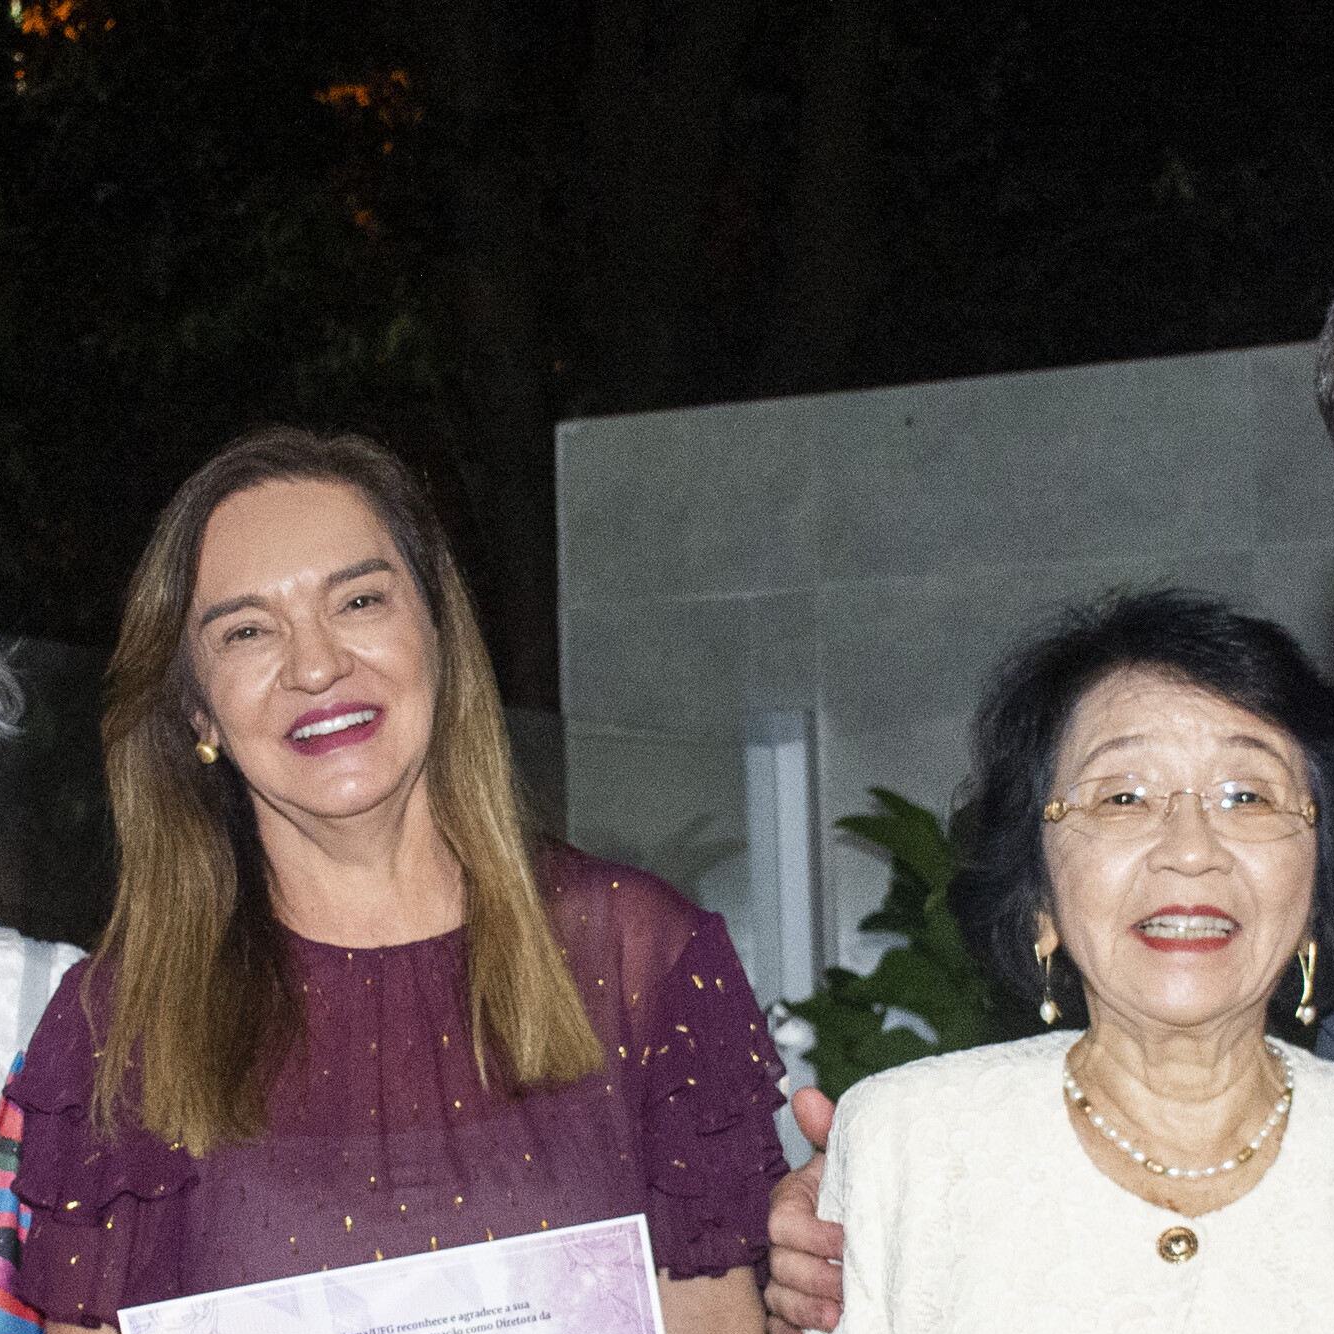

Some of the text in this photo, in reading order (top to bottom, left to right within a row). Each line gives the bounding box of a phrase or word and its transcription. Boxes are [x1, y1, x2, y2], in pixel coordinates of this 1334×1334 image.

[397, 1316, 448, 1332] reconhece
[458, 1306, 502, 1323] agradece
[512, 1301, 530, 1311] sua
[466, 1324, 493, 1334] como
[495, 1315, 537, 1329] Diretora
[539, 1310, 551, 1321] da
